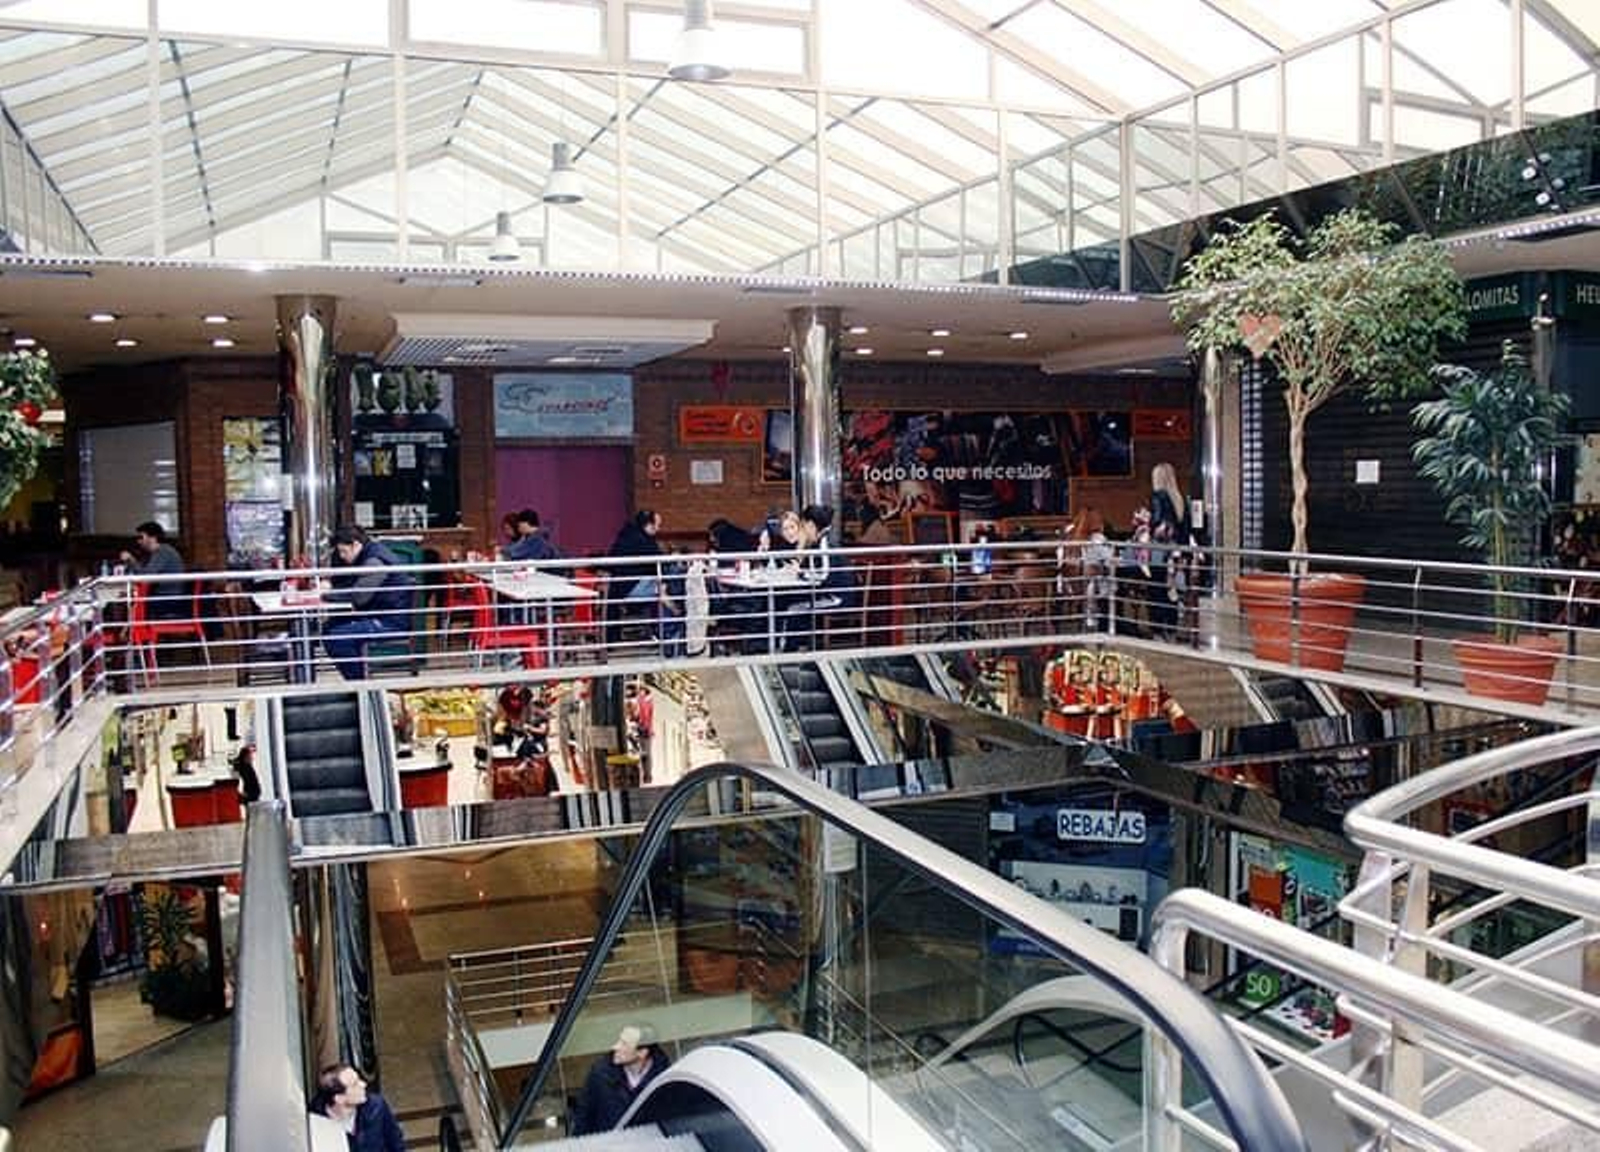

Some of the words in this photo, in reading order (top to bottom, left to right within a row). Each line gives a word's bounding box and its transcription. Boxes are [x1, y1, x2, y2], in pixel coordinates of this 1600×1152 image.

[863, 464, 906, 482] Todo
[911, 463, 928, 480] lo
[933, 466, 967, 483] que
[1060, 814, 1143, 838] REBAJAS
